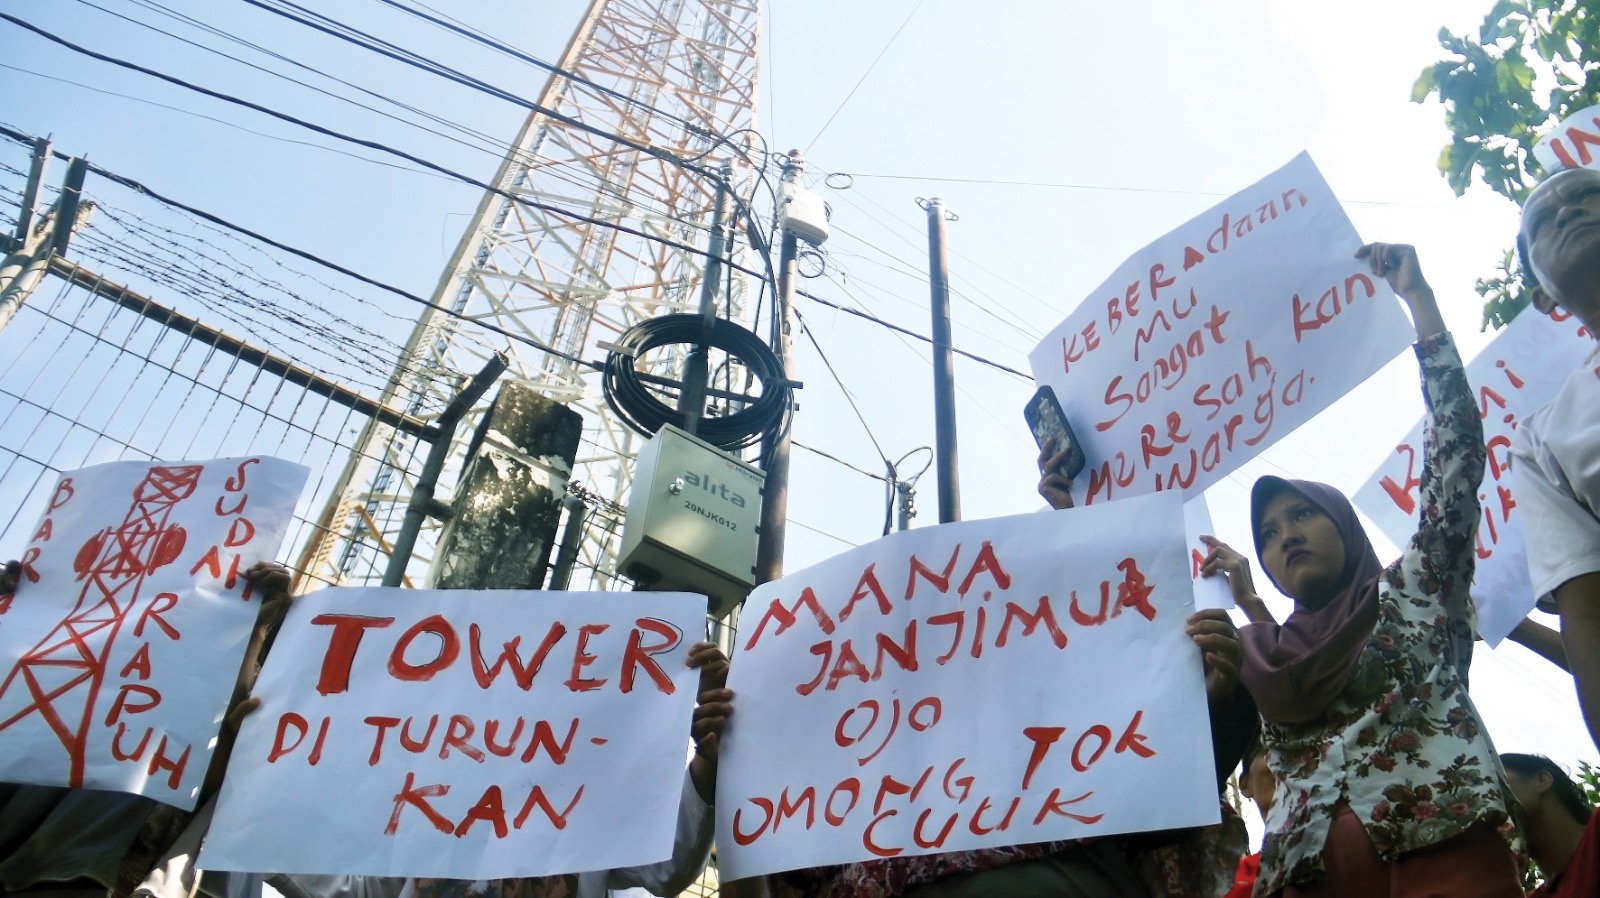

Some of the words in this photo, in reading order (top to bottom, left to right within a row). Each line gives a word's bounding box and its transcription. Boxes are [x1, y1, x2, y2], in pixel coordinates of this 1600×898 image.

[684, 469, 746, 509] alita
[684, 499, 737, 532] 20NJK012
[744, 540, 1011, 651] MANA
[105, 592, 192, 790] RAPUH
[310, 614, 684, 697] TOWER
[266, 711, 331, 766] DI
[383, 772, 586, 840] KAN
[732, 757, 976, 847] OMONG
